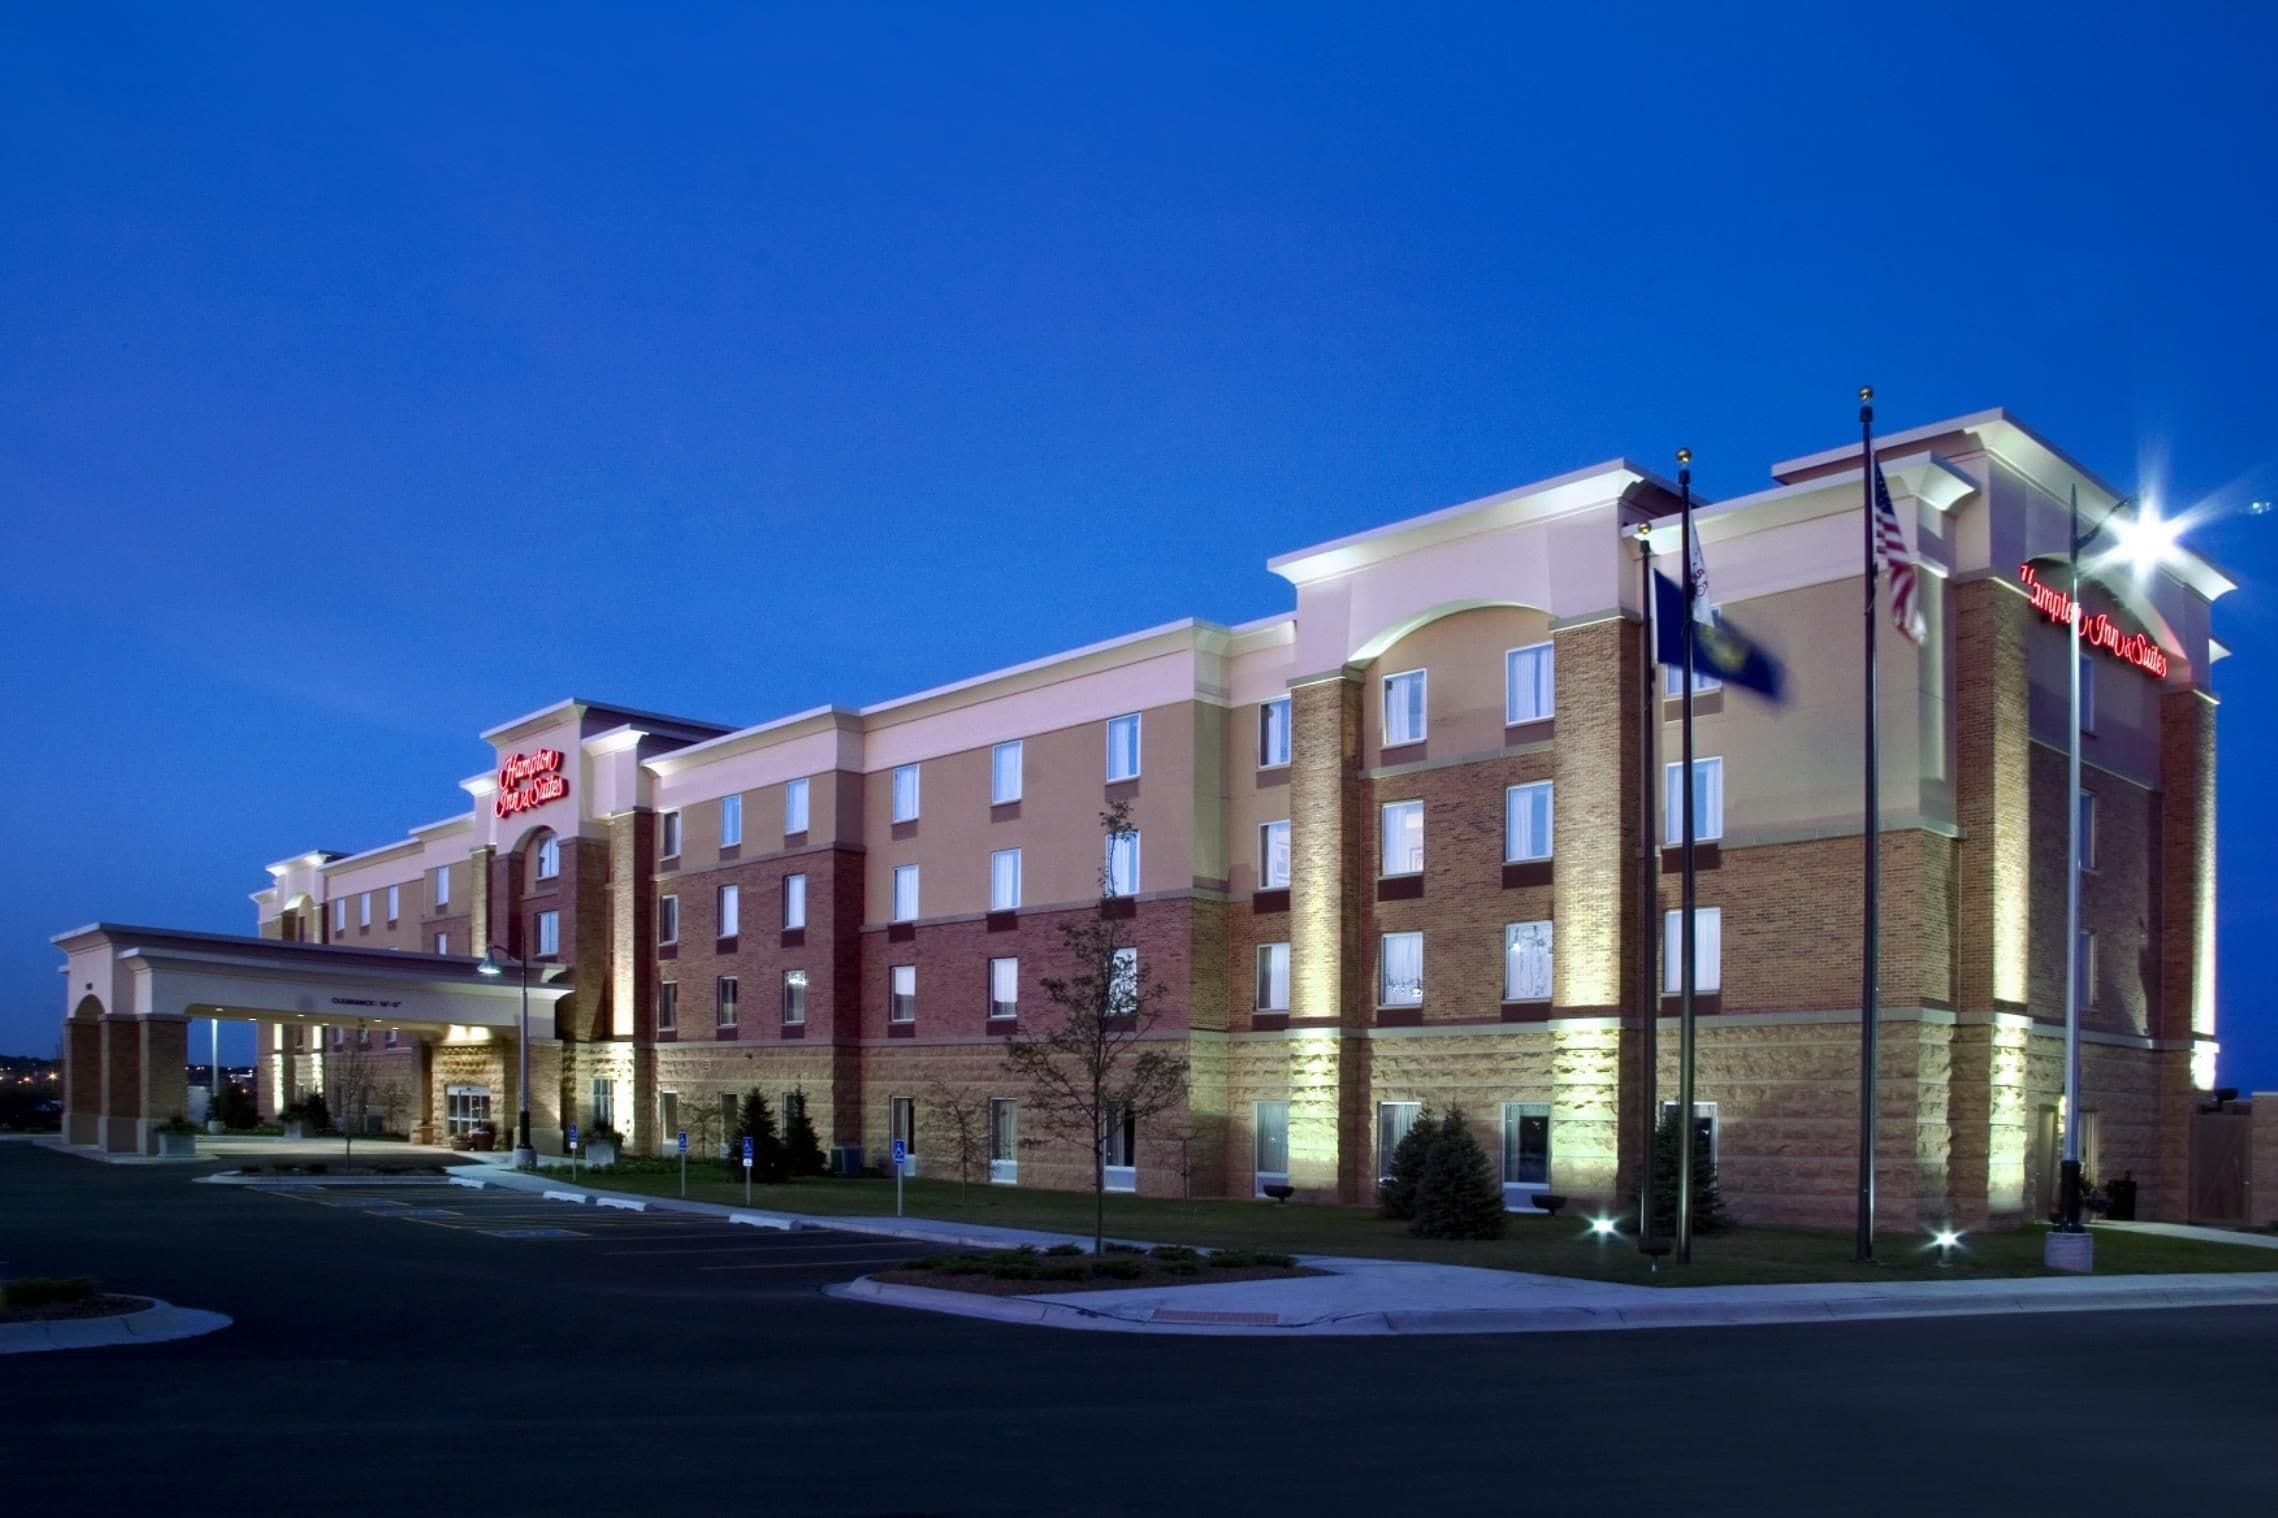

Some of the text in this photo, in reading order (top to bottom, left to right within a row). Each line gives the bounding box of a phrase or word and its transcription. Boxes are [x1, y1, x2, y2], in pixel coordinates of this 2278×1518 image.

[2088, 613, 2125, 657] Inn
[2131, 633, 2167, 678] Suites
[498, 748, 561, 791] Hampton
[495, 789, 523, 818] Inn
[529, 775, 564, 805] Suites
